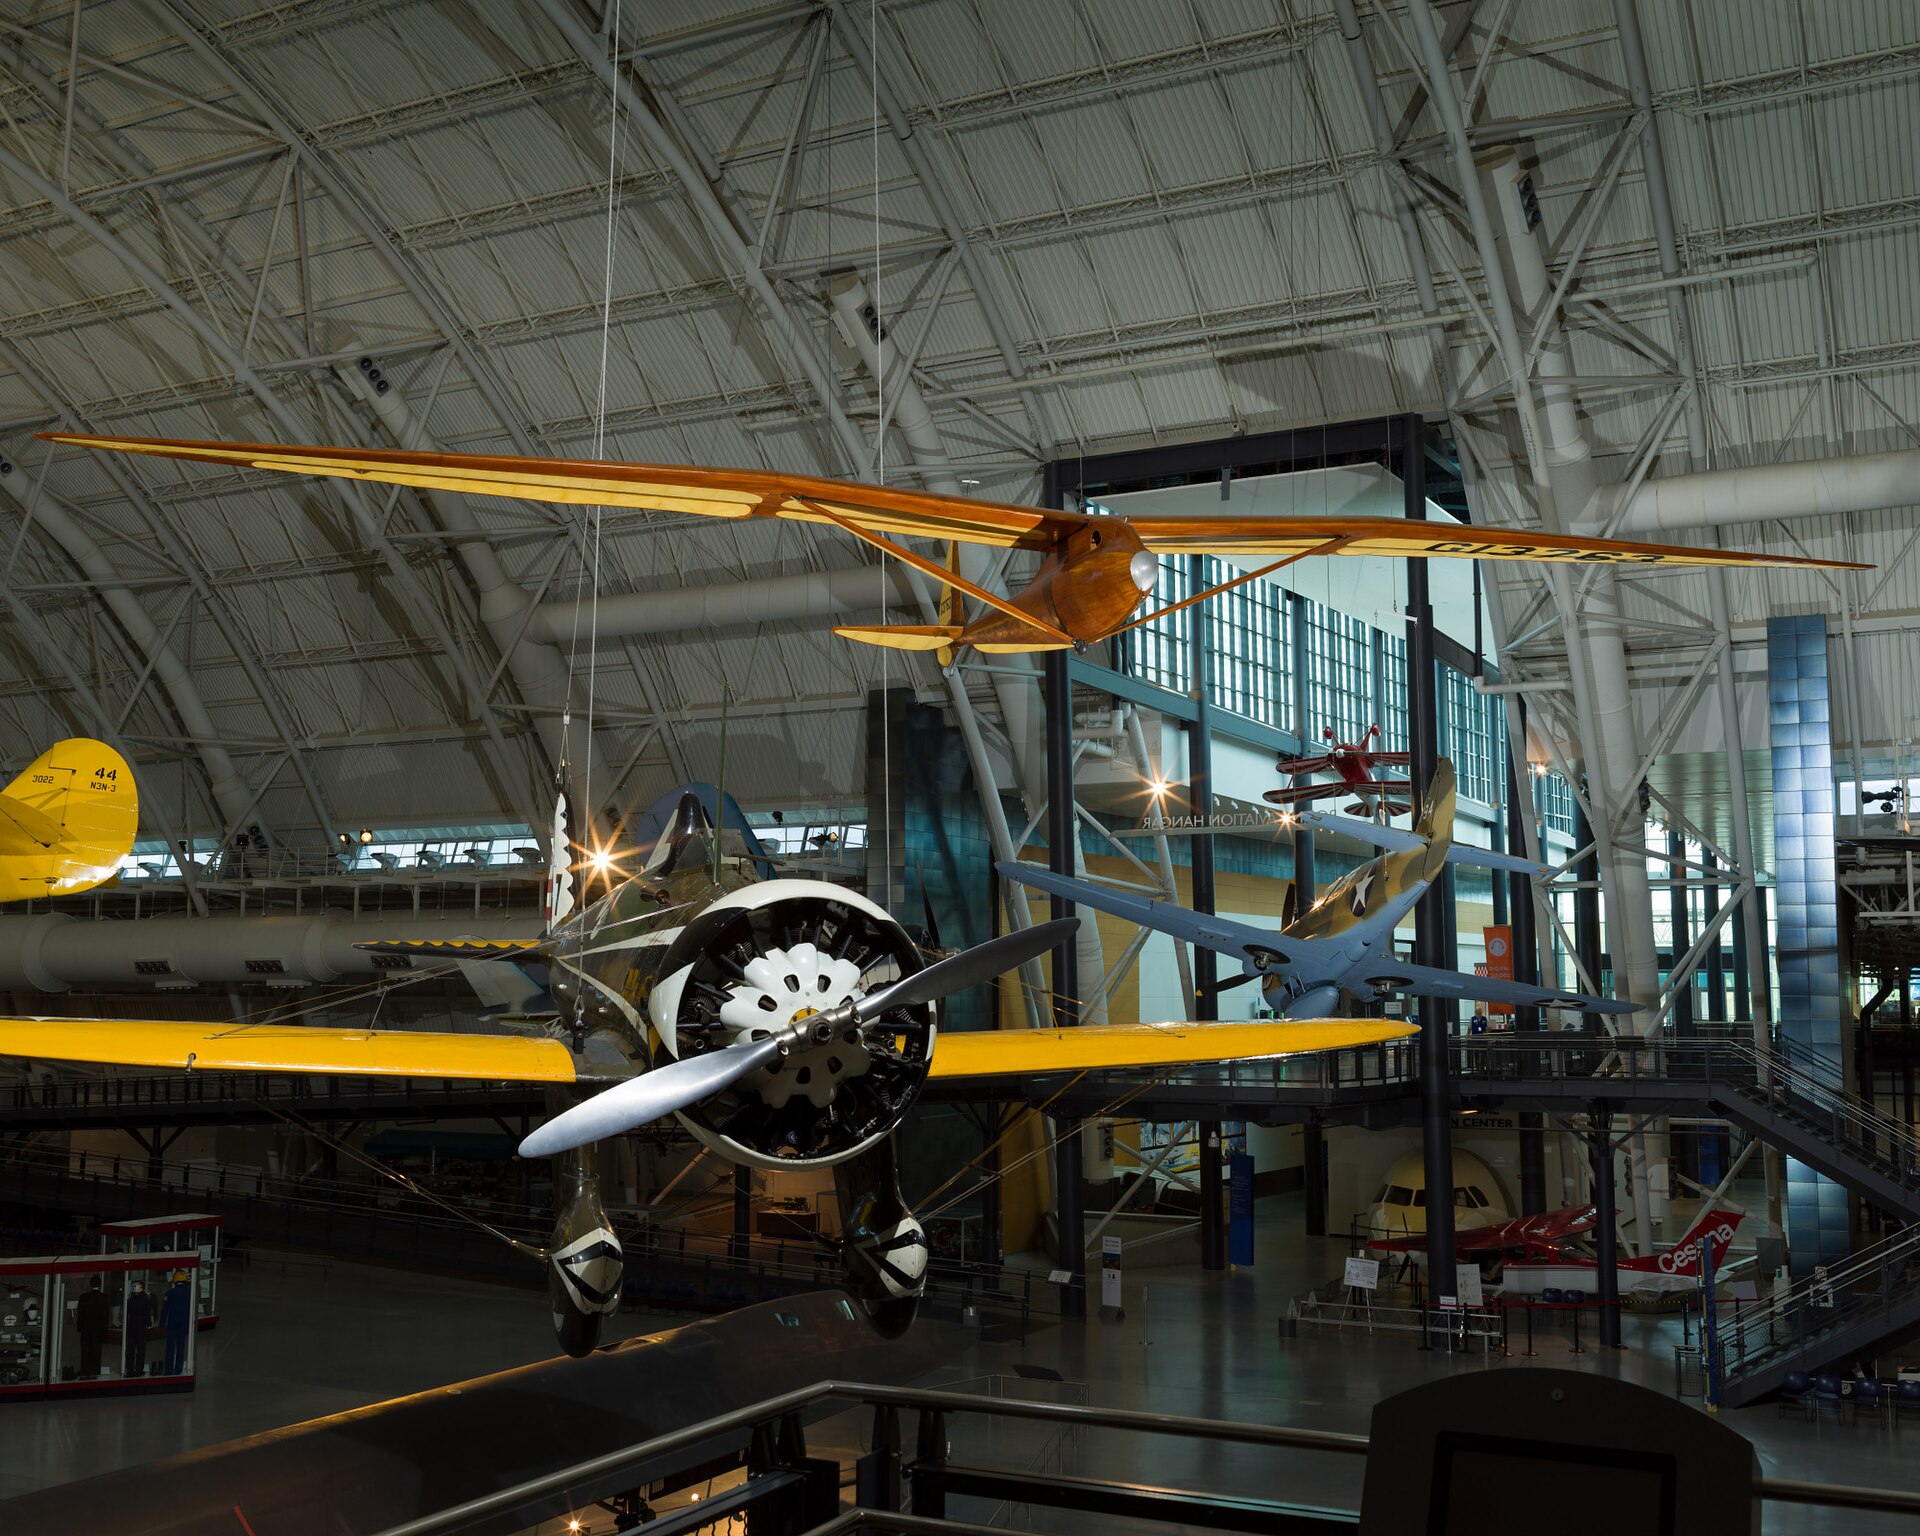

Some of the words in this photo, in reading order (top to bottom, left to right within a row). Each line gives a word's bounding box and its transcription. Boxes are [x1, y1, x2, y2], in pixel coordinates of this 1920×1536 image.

[32, 775, 54, 784] 3022
[95, 767, 117, 781] 44
[90, 781, 117, 793] N3N-3
[1462, 1118, 1513, 1128] CENTER
